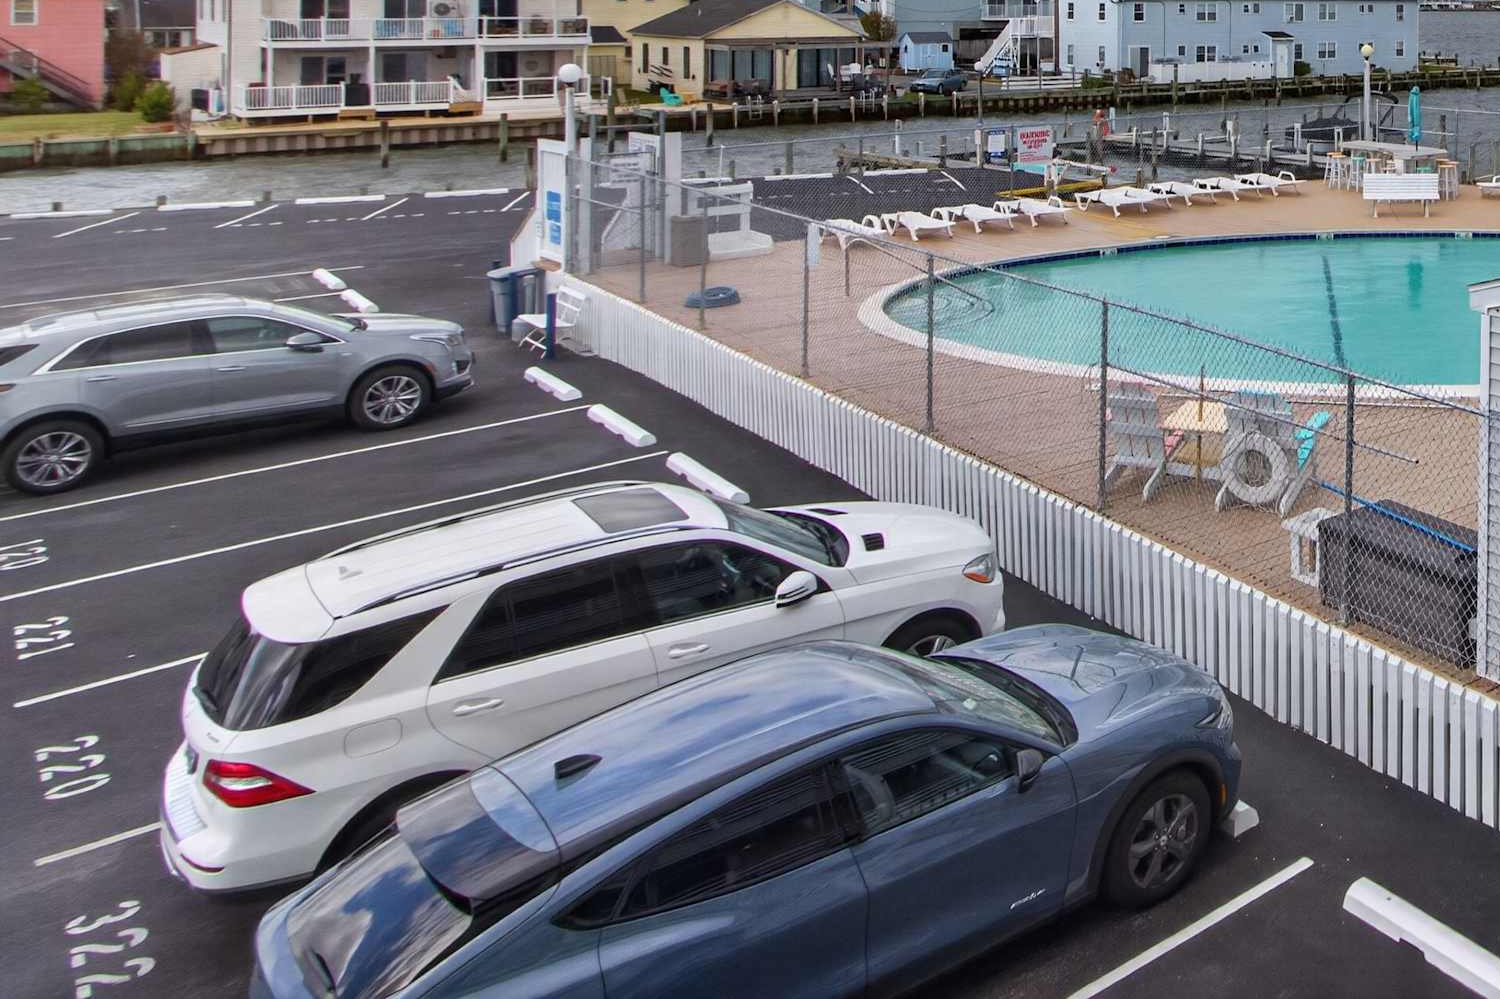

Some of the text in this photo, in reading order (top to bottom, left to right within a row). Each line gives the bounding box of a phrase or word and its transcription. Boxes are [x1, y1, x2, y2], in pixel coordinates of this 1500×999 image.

[14, 616, 74, 660] 221
[35, 735, 111, 800] 220
[64, 900, 156, 999] 322
